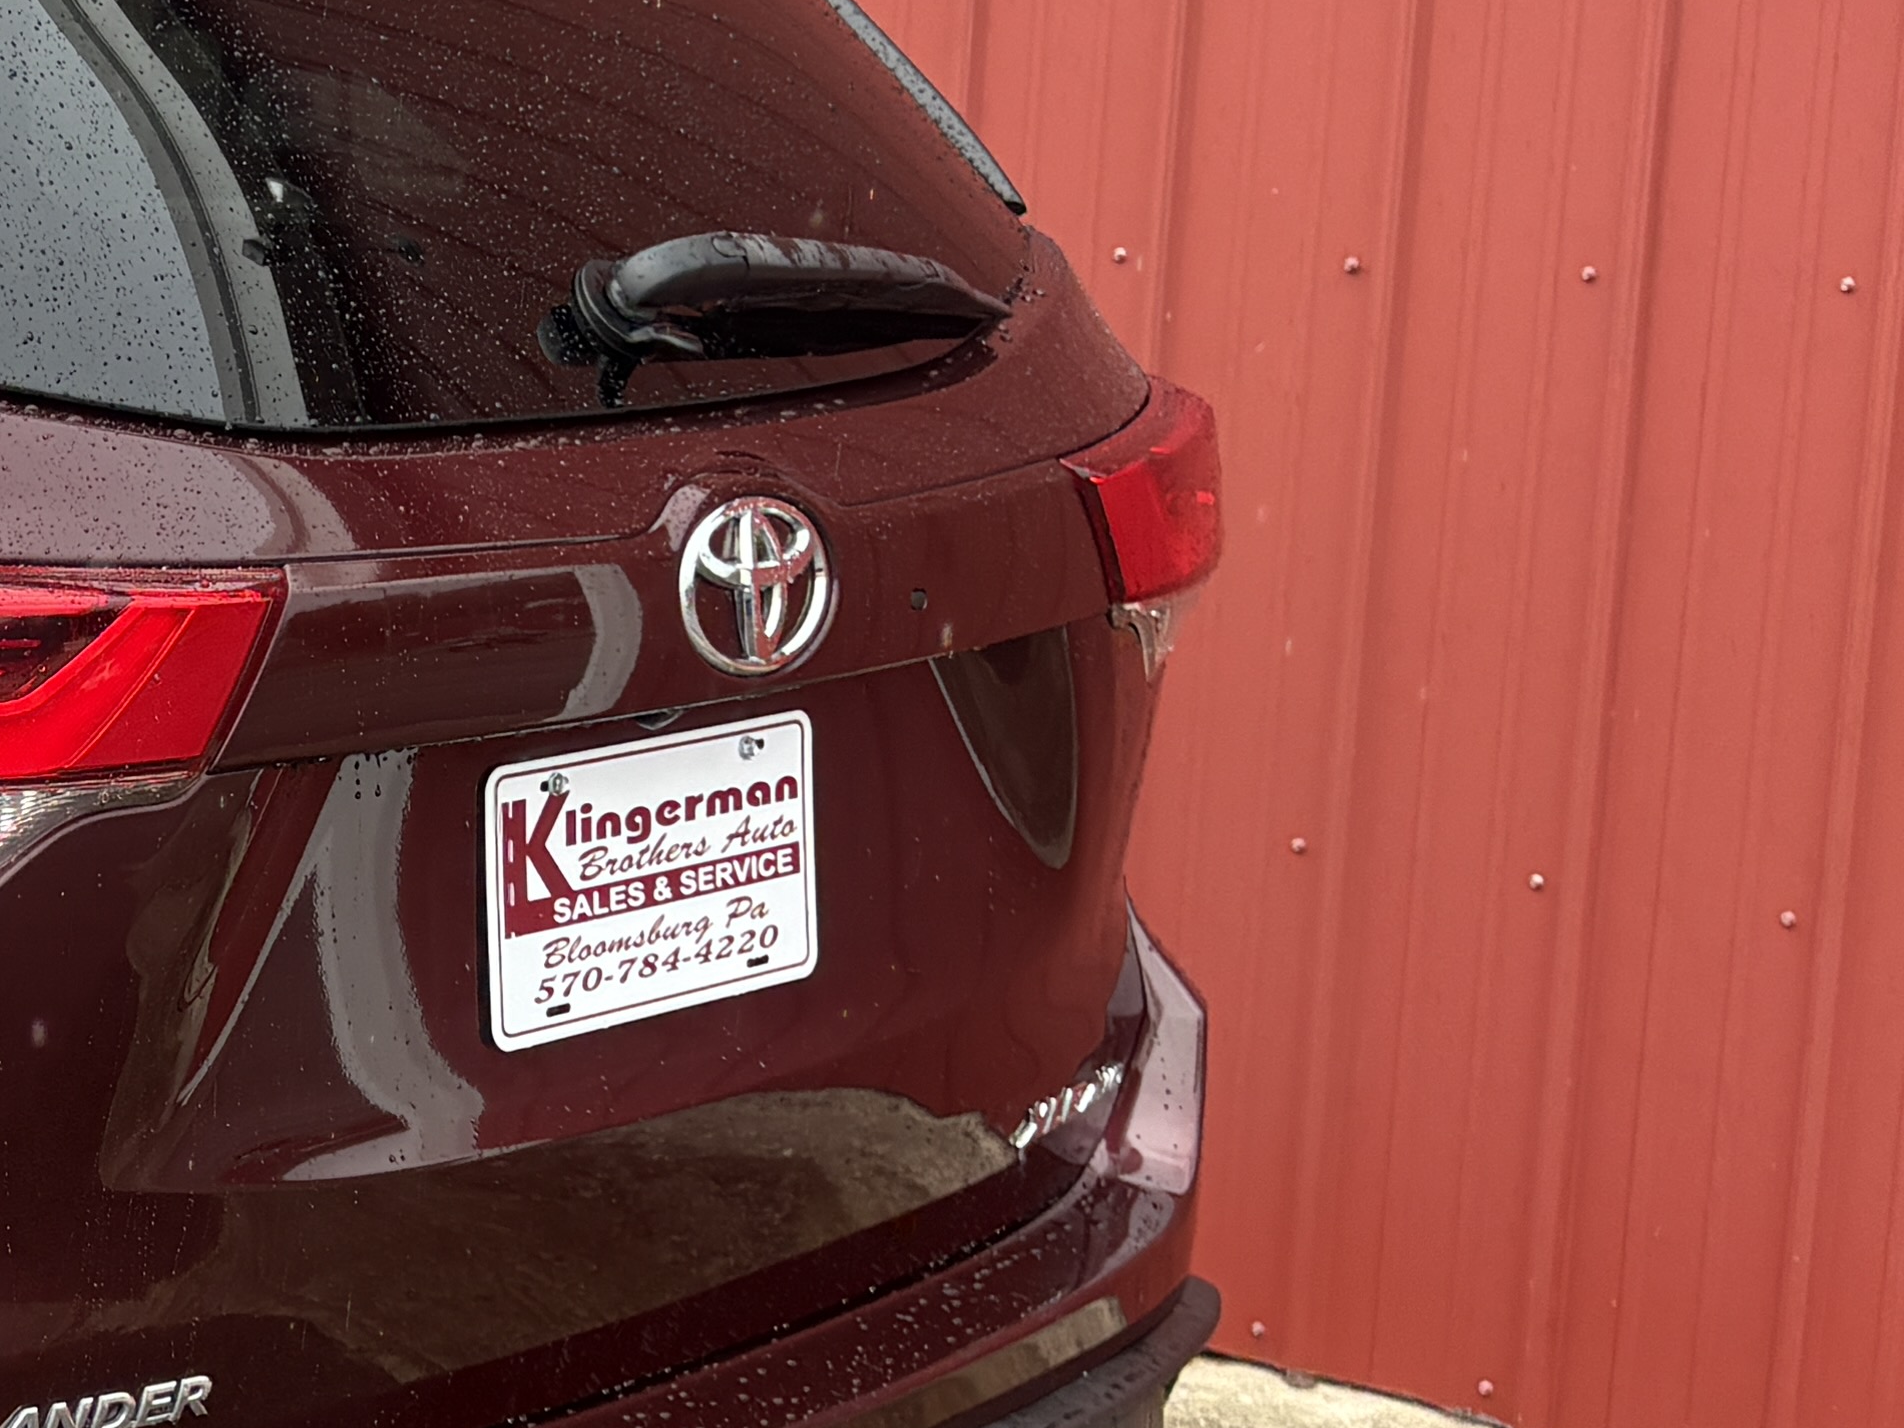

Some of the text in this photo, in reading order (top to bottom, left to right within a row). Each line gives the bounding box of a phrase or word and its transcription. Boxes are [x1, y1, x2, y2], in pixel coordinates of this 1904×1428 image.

[502, 775, 798, 917] Klingerman
[578, 814, 798, 882] Brothers Auto
[553, 847, 794, 924] SALES & SERVICE
[533, 924, 779, 1005] 570-784-4220
[542, 895, 770, 970] Bloomsburg Pa
